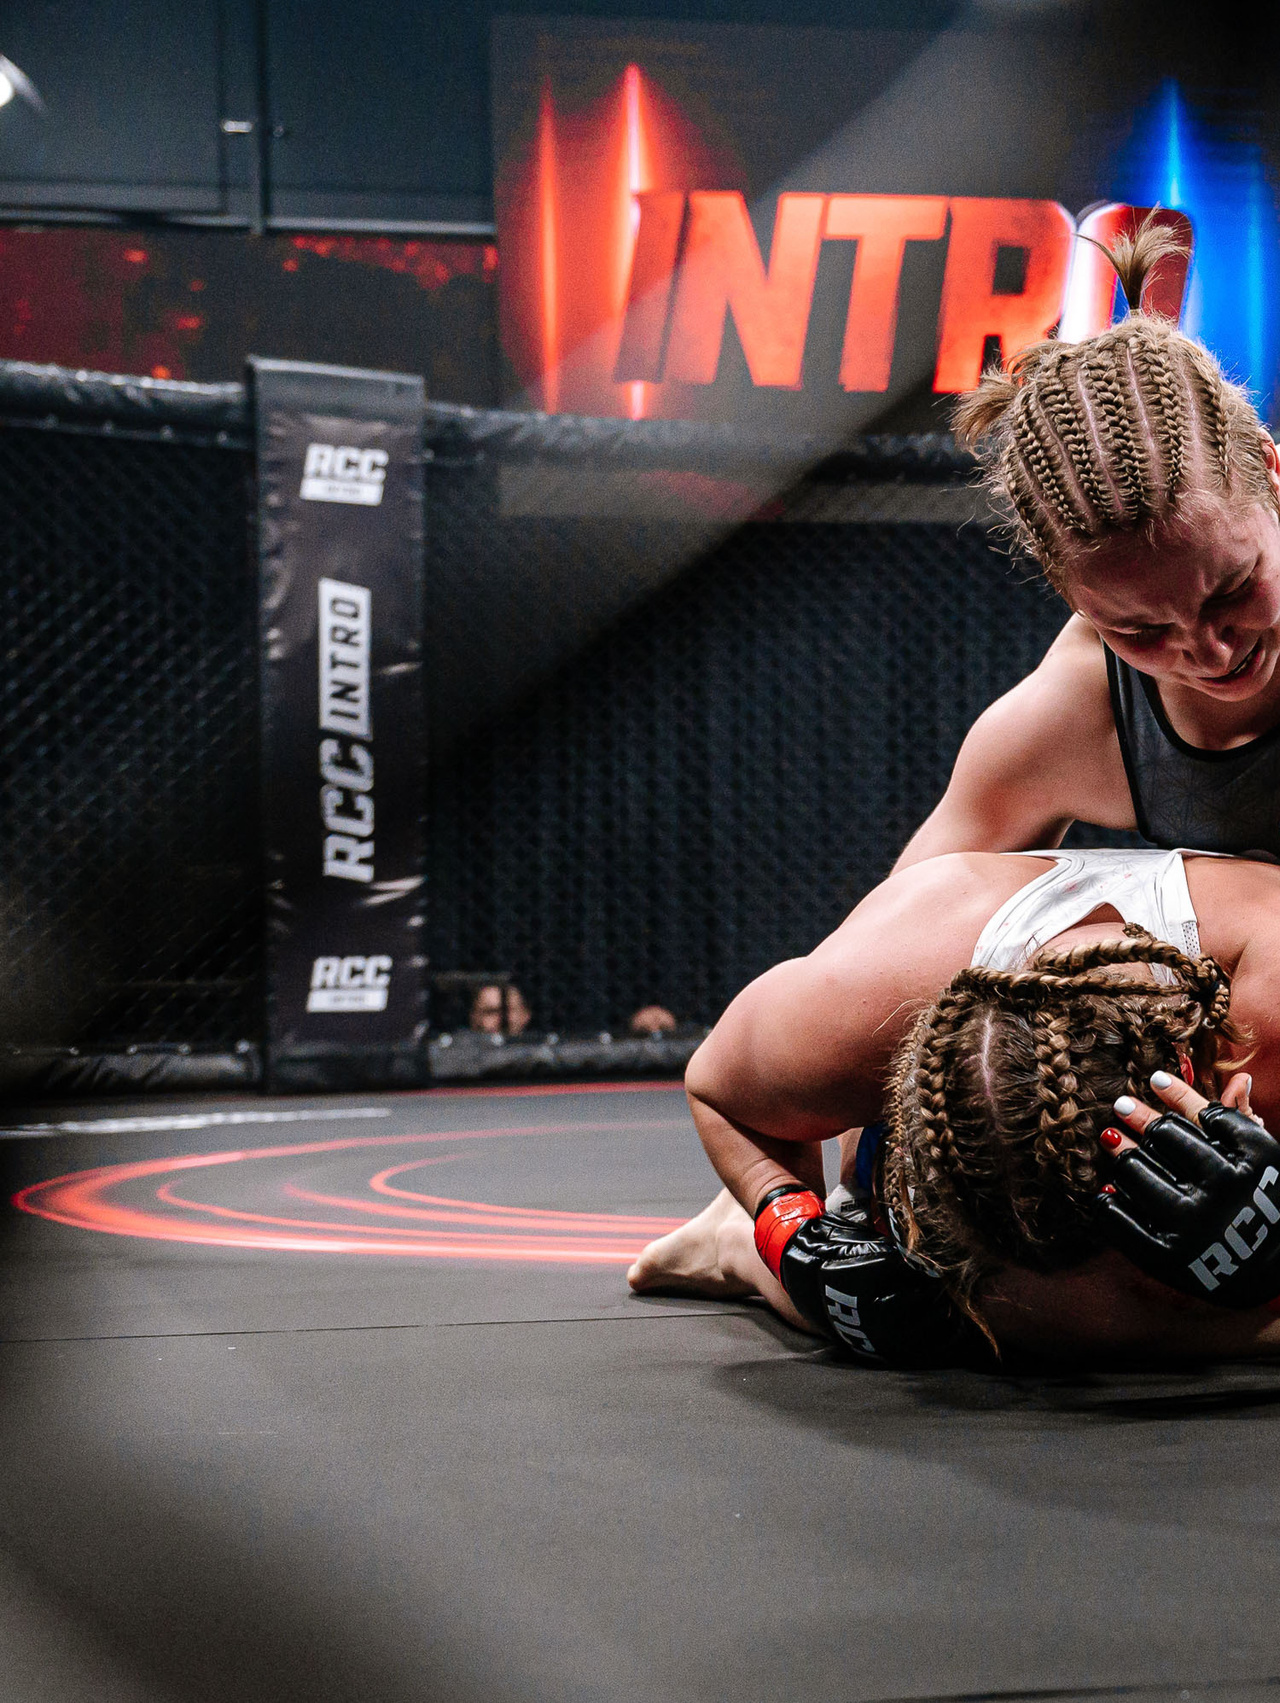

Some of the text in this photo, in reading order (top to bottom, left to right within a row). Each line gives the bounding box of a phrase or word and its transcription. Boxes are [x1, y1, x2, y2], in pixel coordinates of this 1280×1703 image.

[302, 443, 389, 482] RCC
[319, 596, 375, 883] RCC INTRO
[310, 955, 394, 989] RCC
[824, 1284, 876, 1353] RC
